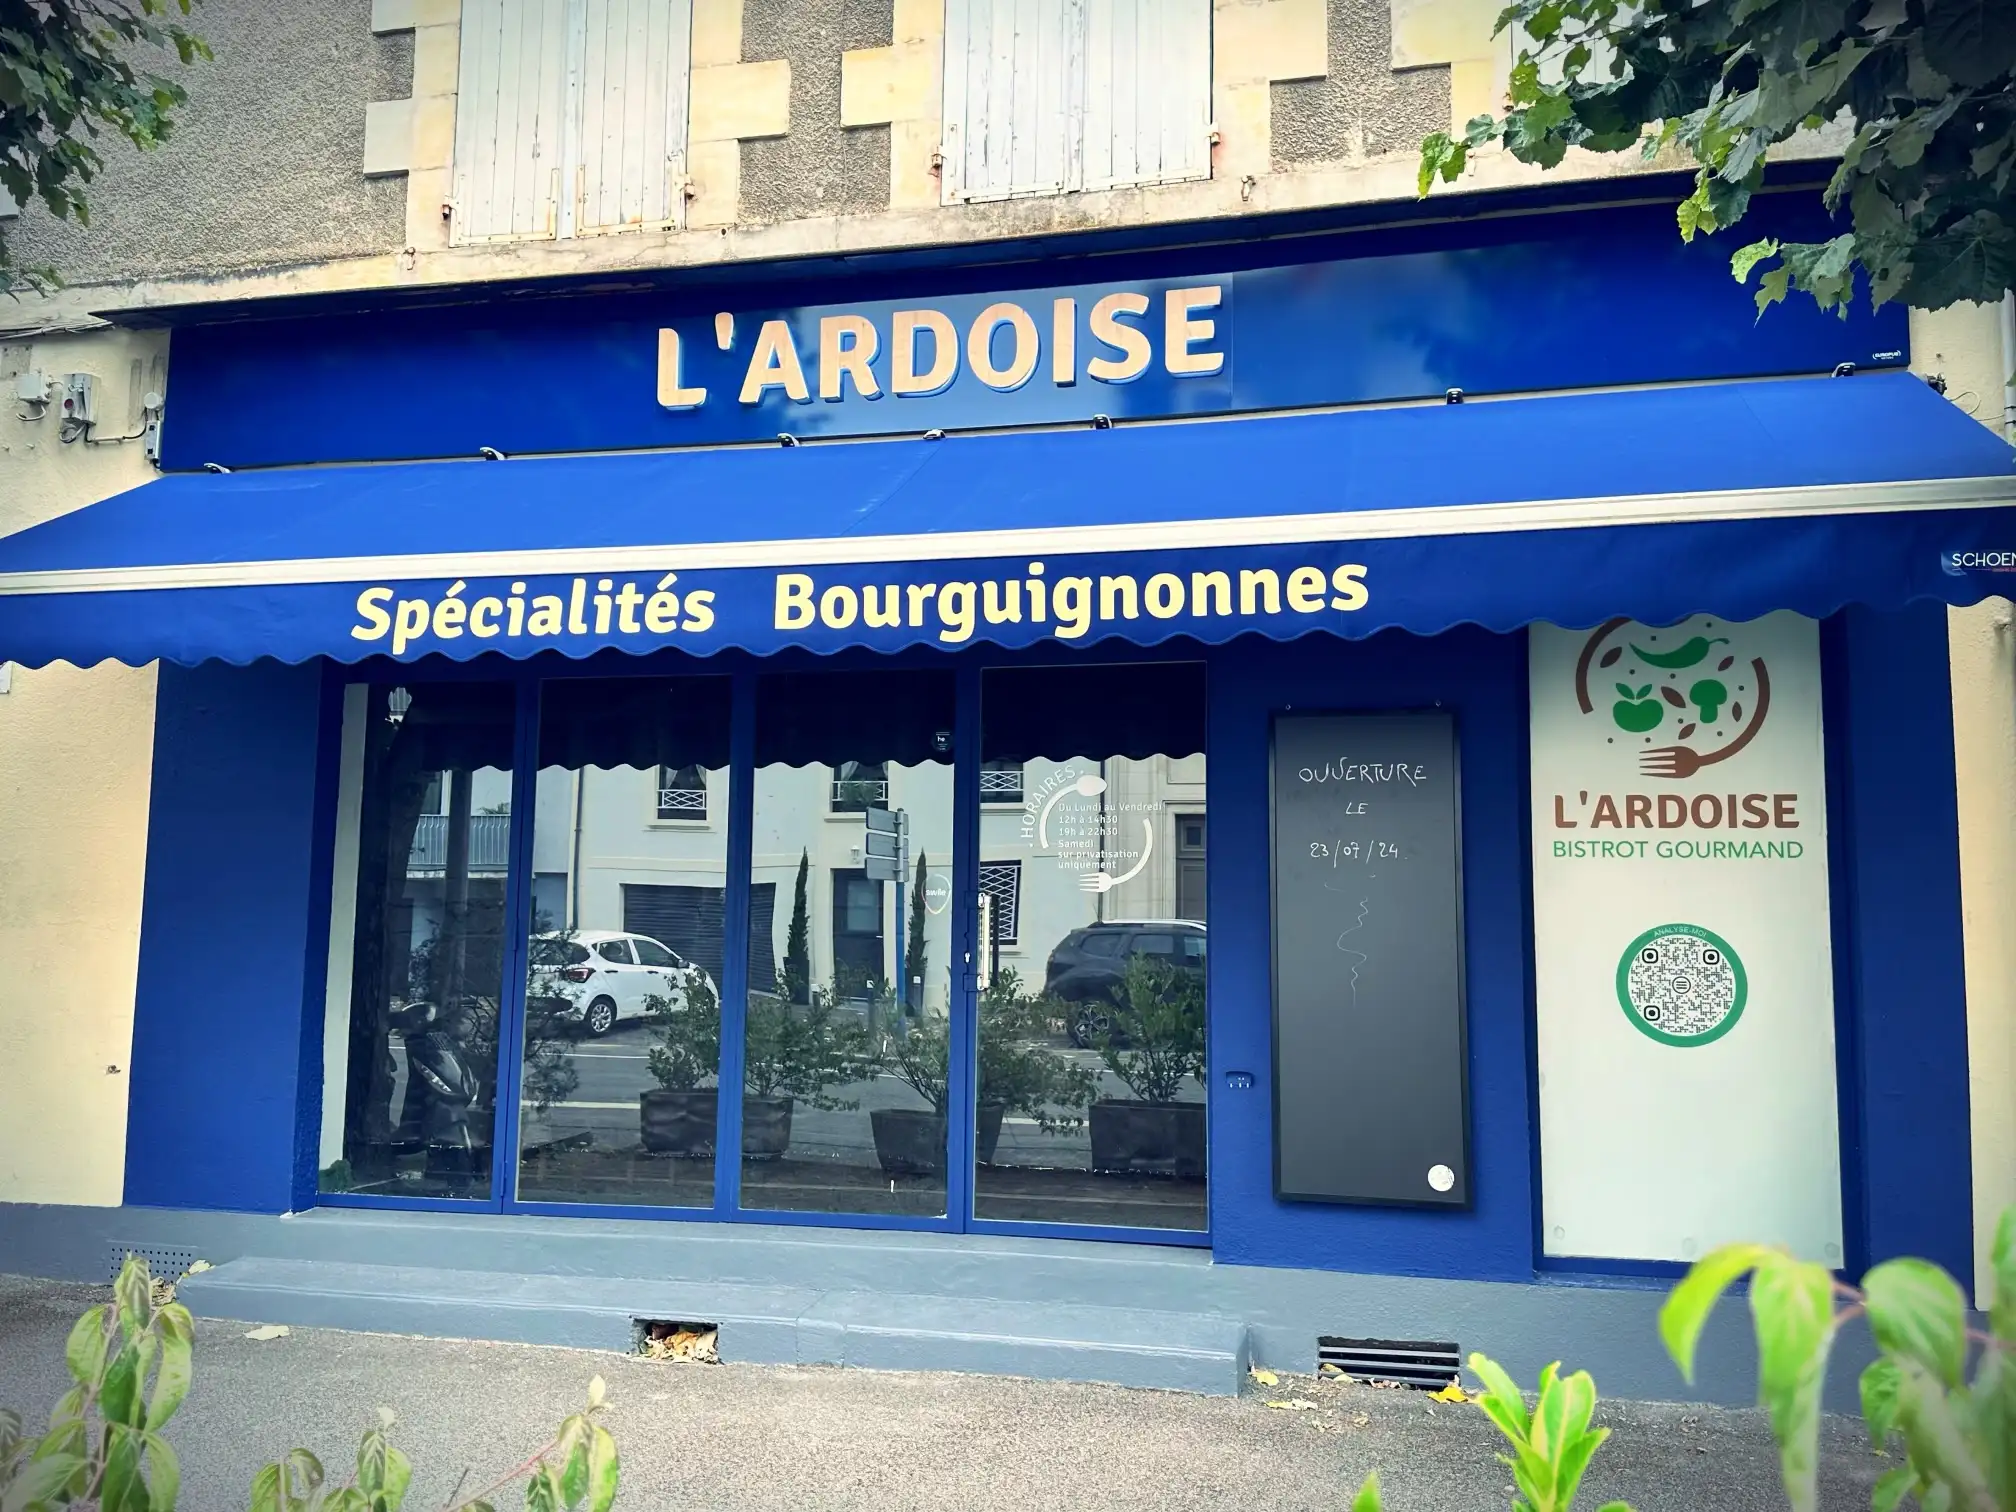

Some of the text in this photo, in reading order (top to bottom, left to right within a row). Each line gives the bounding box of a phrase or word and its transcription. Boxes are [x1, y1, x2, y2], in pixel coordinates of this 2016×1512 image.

[657, 285, 1225, 408] L'ARDOISE
[350, 562, 1370, 656] Spécialités Bourguignonnes
[1298, 757, 1427, 787] OUVERTURE
[1020, 765, 1076, 838] HORAIRES
[1059, 803, 1072, 812] Du
[1075, 802, 1101, 811] Lundi
[1119, 801, 1162, 811] Vendredi
[1345, 802, 1369, 815] LE
[1554, 790, 1800, 829] L'ARDOISE
[1059, 815, 1118, 824] 12h à 14h30
[1059, 827, 1118, 836] 19h à 22h30
[1058, 839, 1094, 848] Samedi
[1553, 840, 1804, 859] BISTROT GOURMAND
[1058, 849, 1139, 860] sur privatisation
[1058, 860, 1117, 870] uniquement
